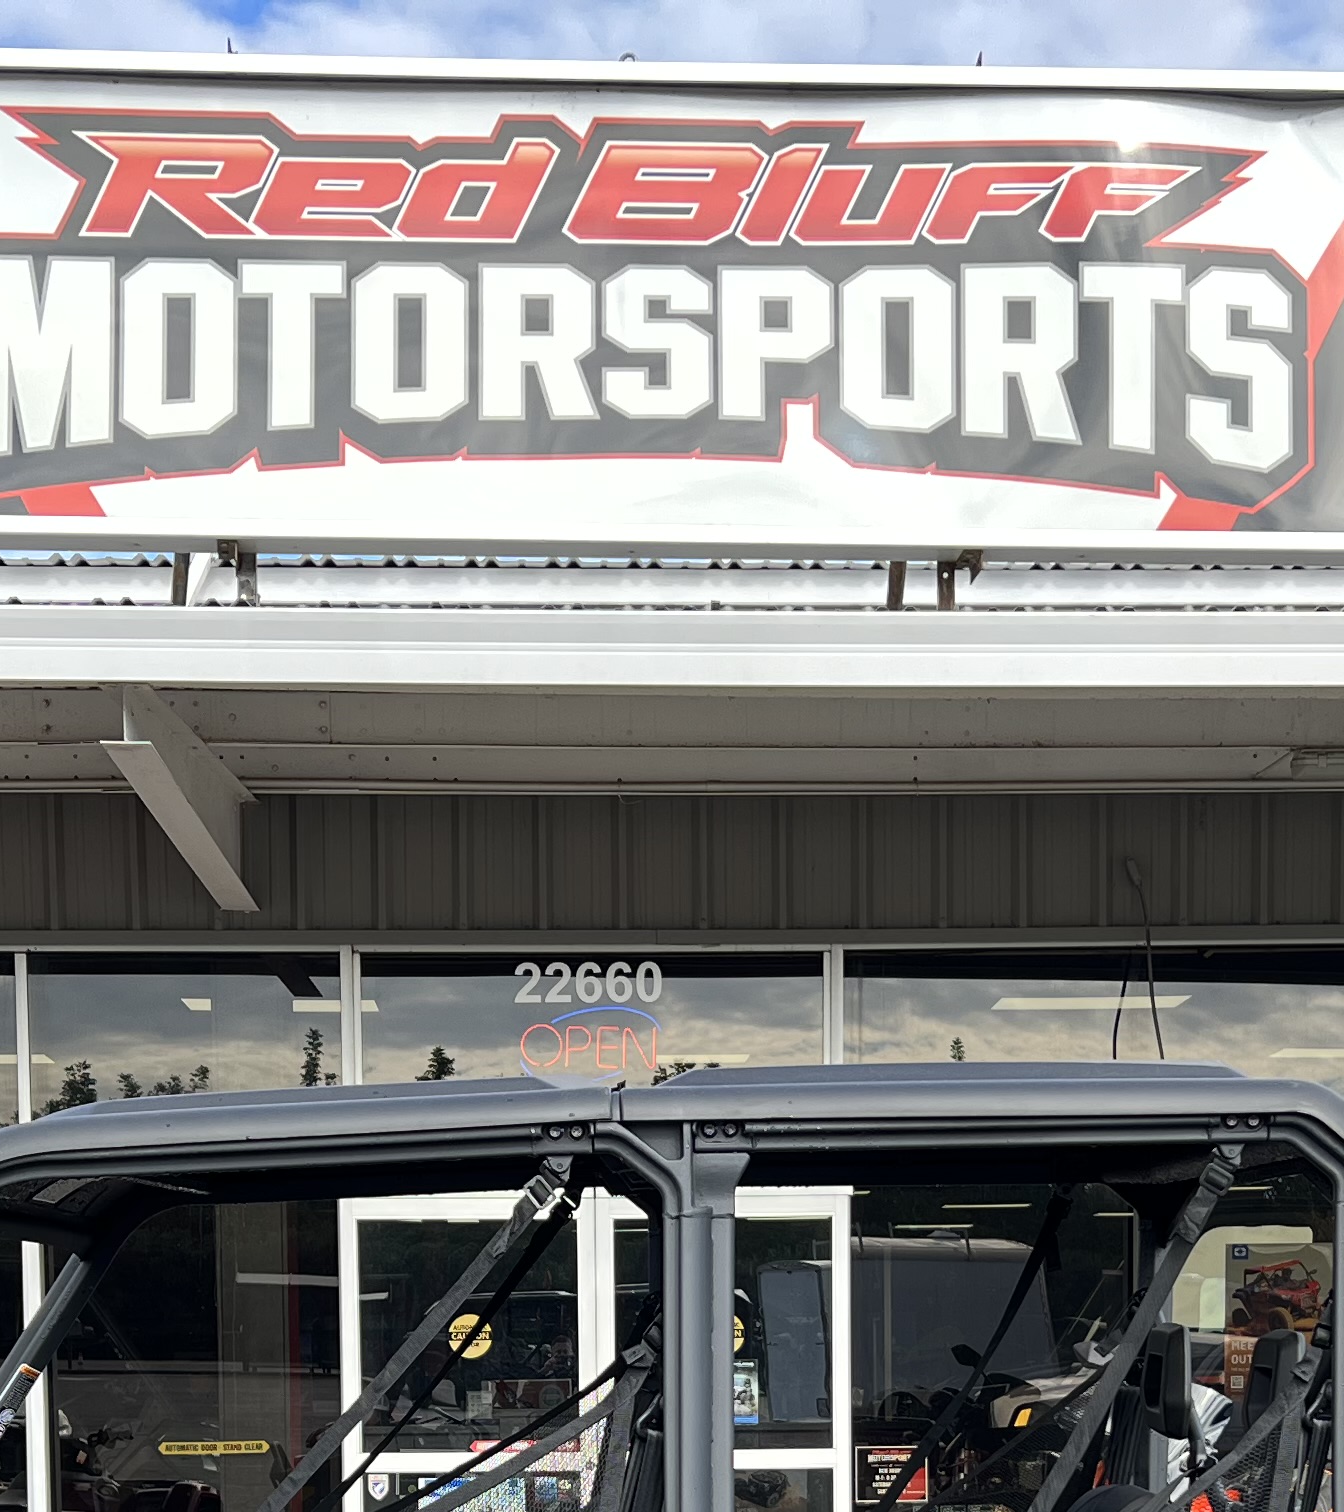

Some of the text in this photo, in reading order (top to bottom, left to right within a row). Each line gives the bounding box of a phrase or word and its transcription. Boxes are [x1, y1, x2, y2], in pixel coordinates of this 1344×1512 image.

[72, 130, 560, 243] Red
[514, 961, 663, 1004] 22660
[520, 1023, 658, 1070] OPEN
[165, 1444, 199, 1452] AUTOMATIC
[223, 1443, 243, 1451] STAND
[244, 1442, 264, 1450] CLEAR
